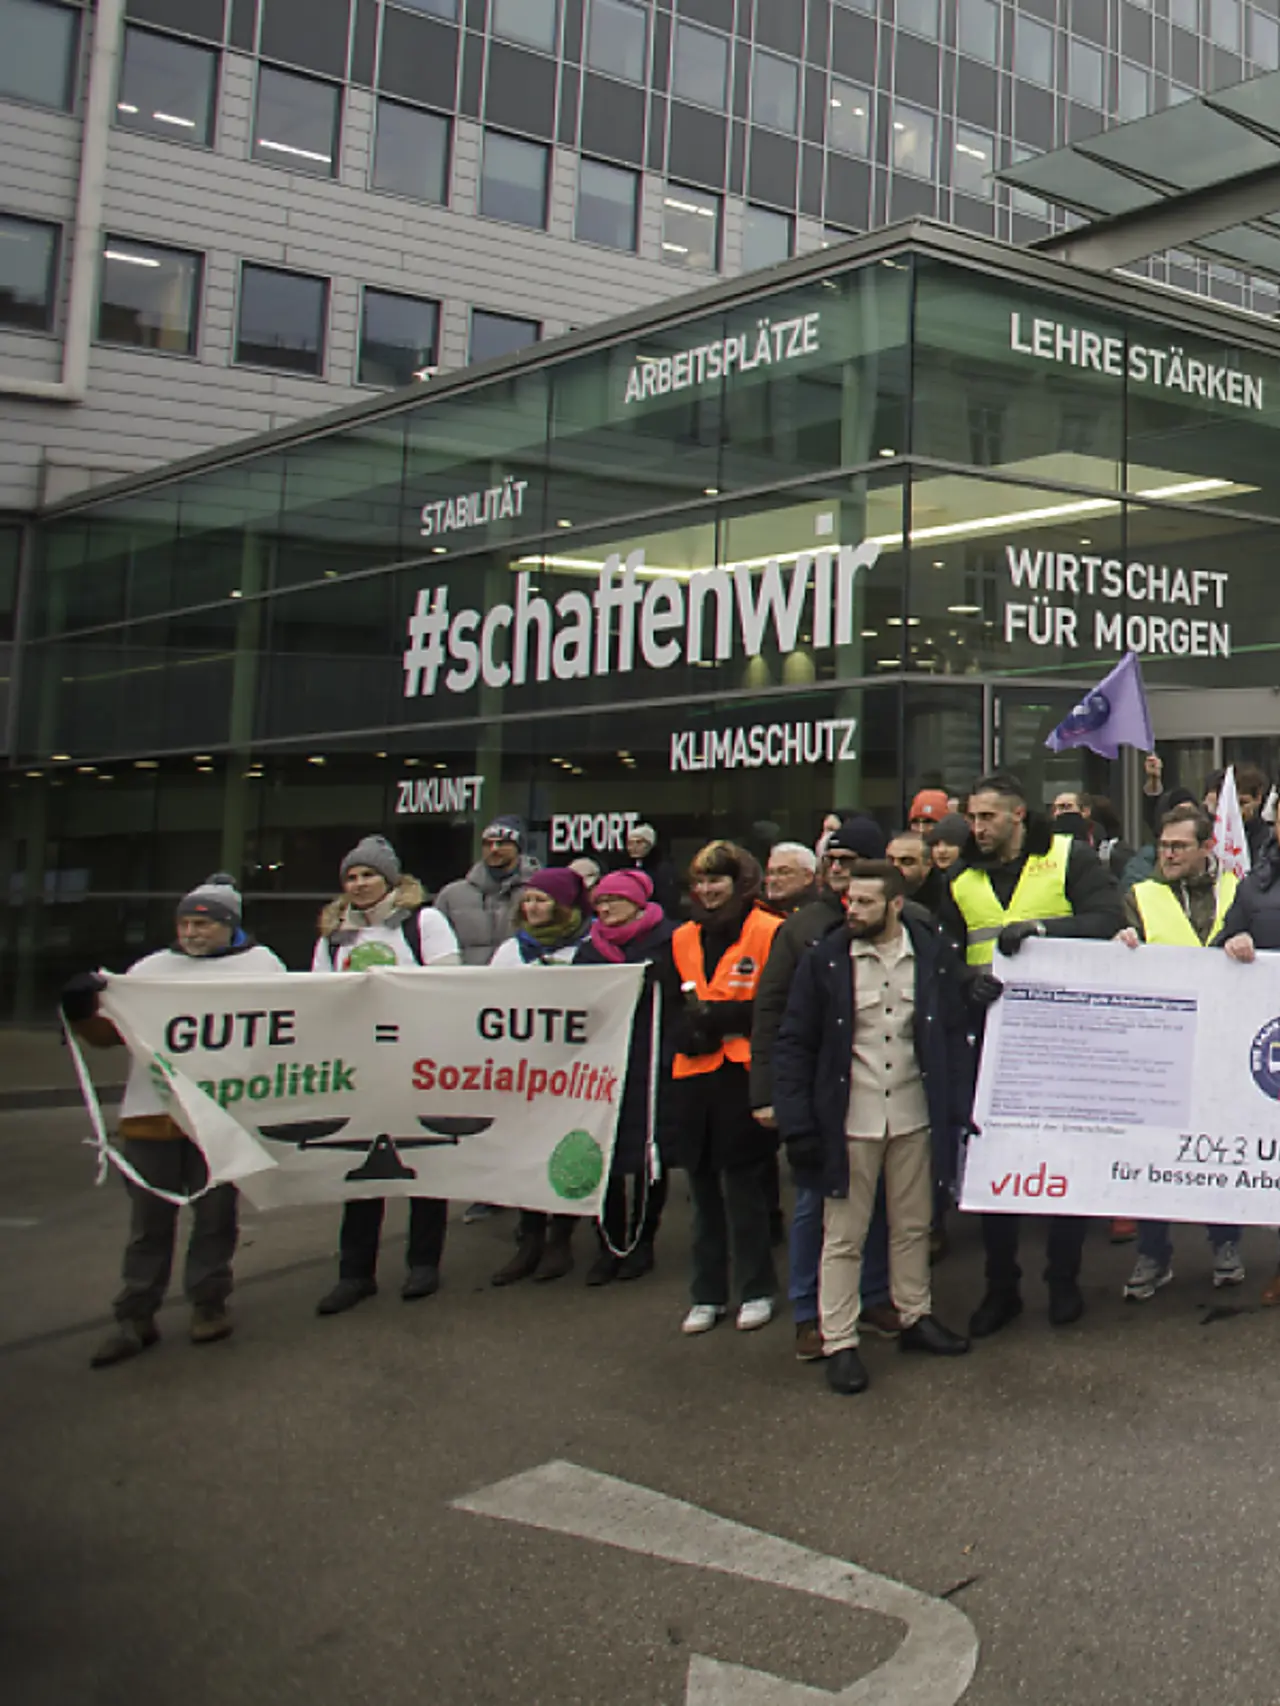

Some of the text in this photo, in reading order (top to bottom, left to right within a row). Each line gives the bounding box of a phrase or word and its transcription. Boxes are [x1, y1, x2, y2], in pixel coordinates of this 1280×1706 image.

[625, 312, 820, 404] ARBEITSPLÄTZE
[1010, 312, 1263, 410] LEHRE STÄRKEN
[420, 476, 527, 536] STABILITÄT
[1005, 545, 1228, 608] WIRTSCHAFT
[403, 511, 880, 697] #schaffenwir
[1004, 596, 1231, 658] FÜR MORGEN
[670, 718, 856, 772] KLIMASCHUTZ
[396, 775, 484, 814] ZUKUNFT
[550, 812, 640, 853] EXPORT
[165, 1009, 296, 1054] GUTE
[478, 1007, 588, 1044] GUTE
[411, 1056, 618, 1104] Sozialpolitik
[1174, 1135, 1249, 1163] 7043
[989, 1163, 1067, 1199] vida
[1111, 1162, 1143, 1184] für
[1148, 1164, 1228, 1190] bessere
